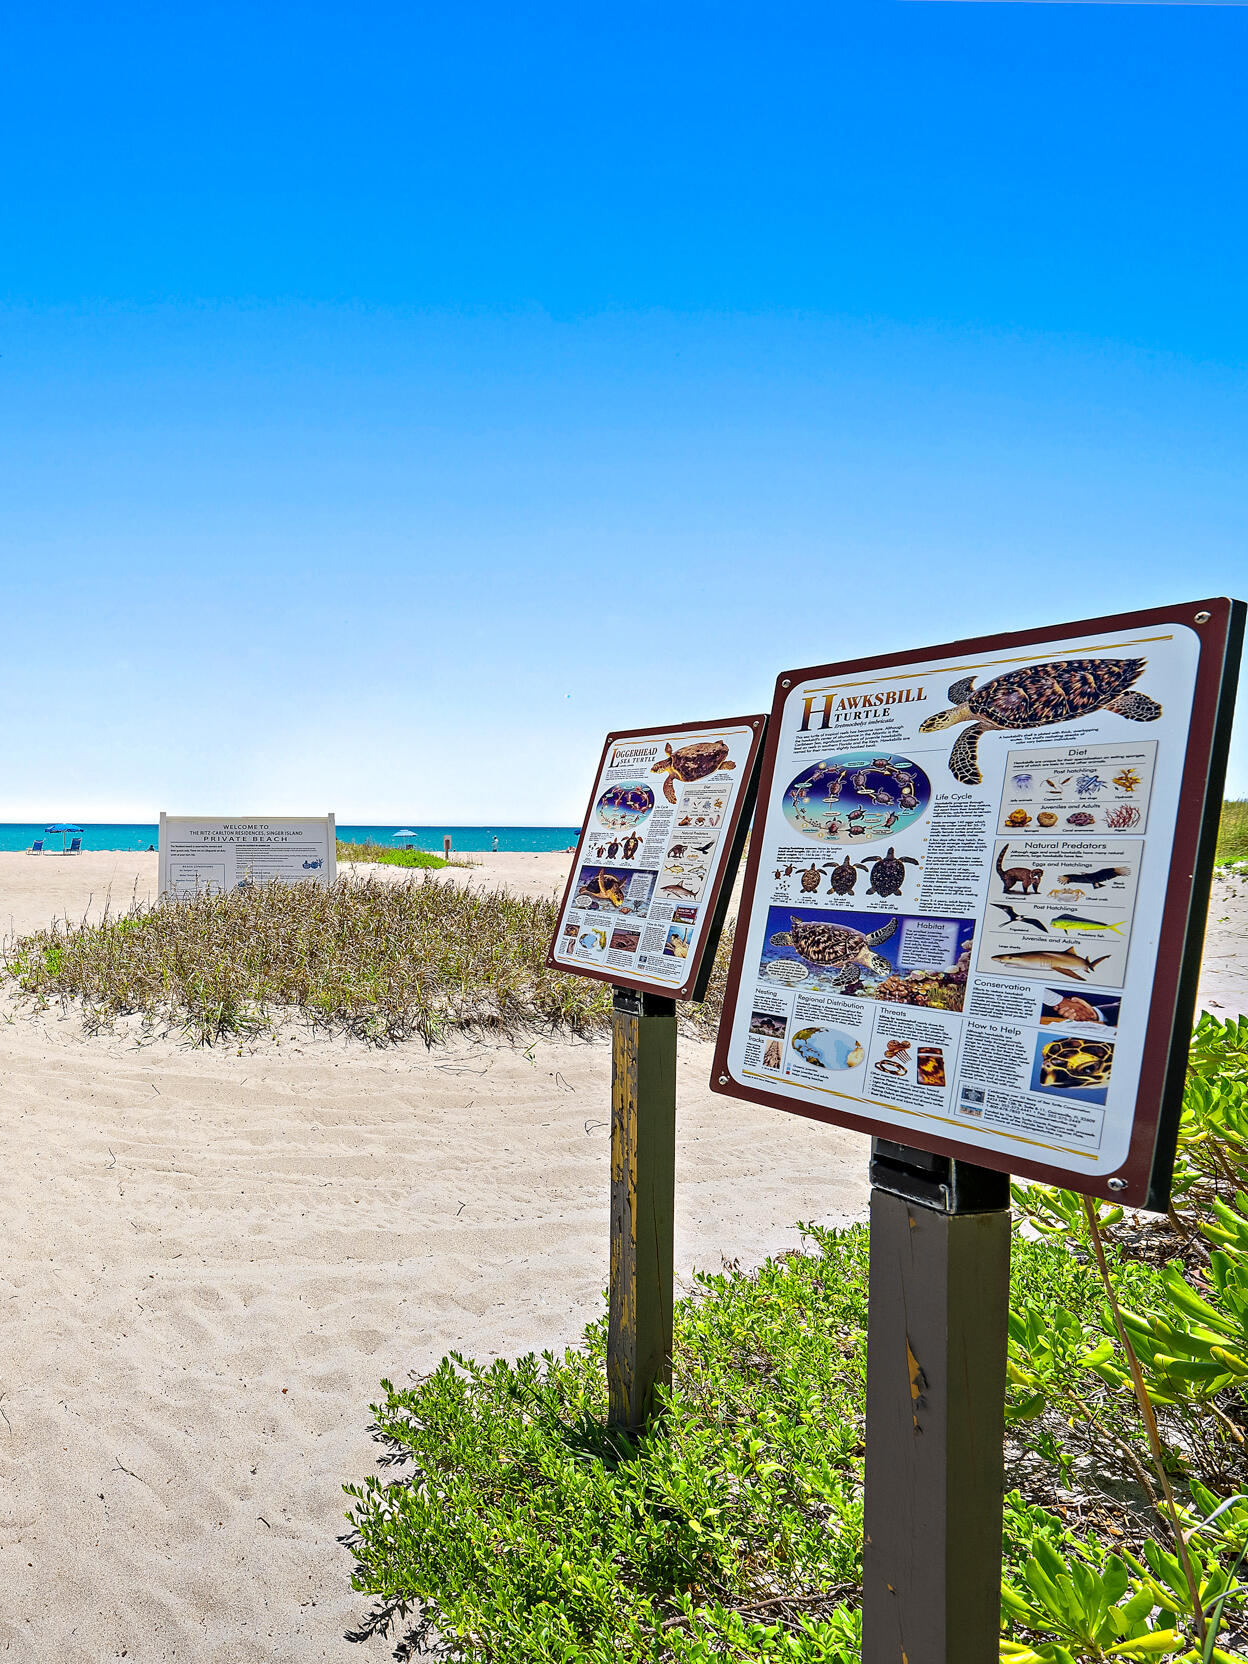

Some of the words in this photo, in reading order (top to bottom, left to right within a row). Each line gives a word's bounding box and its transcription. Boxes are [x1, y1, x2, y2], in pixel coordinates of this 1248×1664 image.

[797, 687, 927, 732] HAWKSBILL
[834, 708, 891, 722] TURTLE
[608, 747, 658, 768] LOGGERHEAD
[974, 978, 1031, 992] Conservation
[756, 988, 777, 997] Nesting
[798, 994, 825, 1004] Regional
[827, 998, 864, 1010] Distribution
[881, 1007, 906, 1016] Threats
[968, 1021, 986, 1030] How
[1000, 1025, 1021, 1036] Help
[748, 1035, 764, 1043] Tracks
